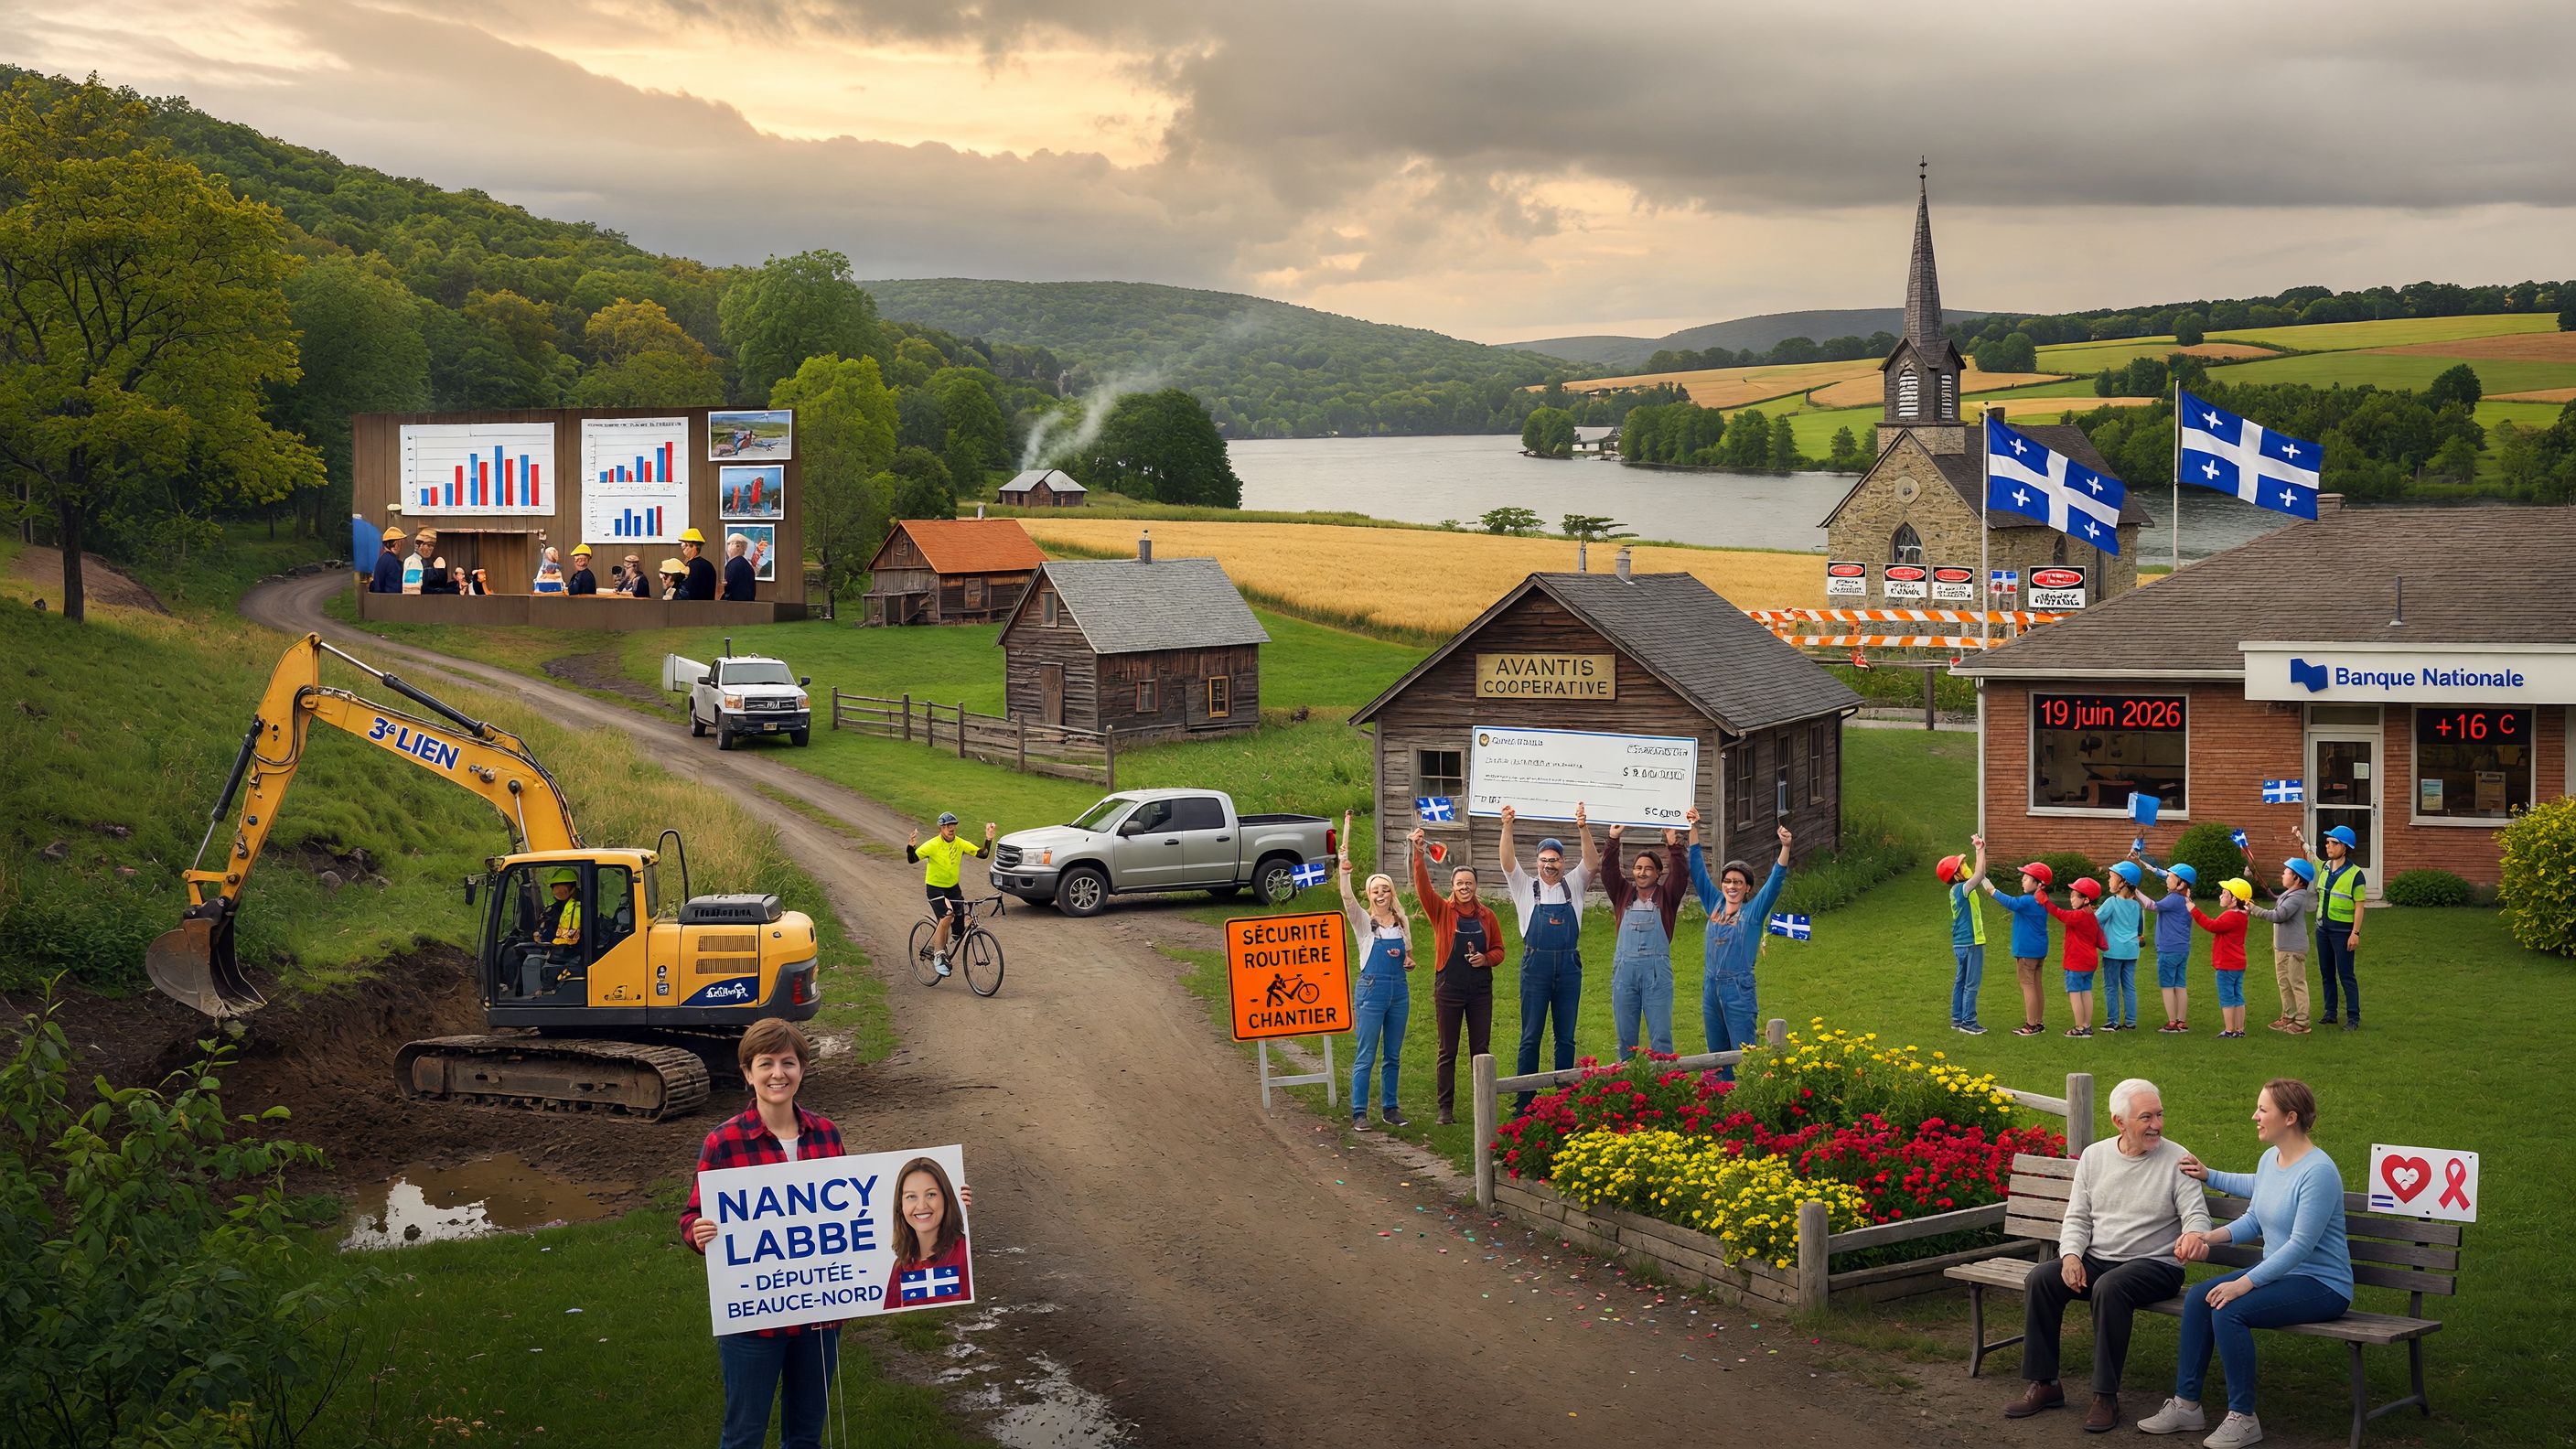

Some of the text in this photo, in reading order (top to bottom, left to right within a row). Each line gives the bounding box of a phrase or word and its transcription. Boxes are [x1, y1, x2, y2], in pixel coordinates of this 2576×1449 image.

[1496, 658, 1594, 677] AVANTIS
[2335, 667, 2525, 690] Banque Nationale
[1484, 680, 1607, 695] COOPERATIVE
[2041, 701, 2181, 730] 19 juin 2026
[2436, 714, 2515, 740] +16 C
[395, 727, 460, 770] LIEN
[1243, 918, 1330, 945] SÉCURITÉ
[1244, 945, 1331, 969] ROUTIÈRE
[1249, 1007, 1336, 1029] CHANTIER
[717, 1175, 879, 1224] NANCY
[724, 1209, 877, 1267] LABBÉ
[756, 1261, 853, 1291] DÉPUTÉE
[727, 1284, 883, 1319] BEAUCE-NORD
